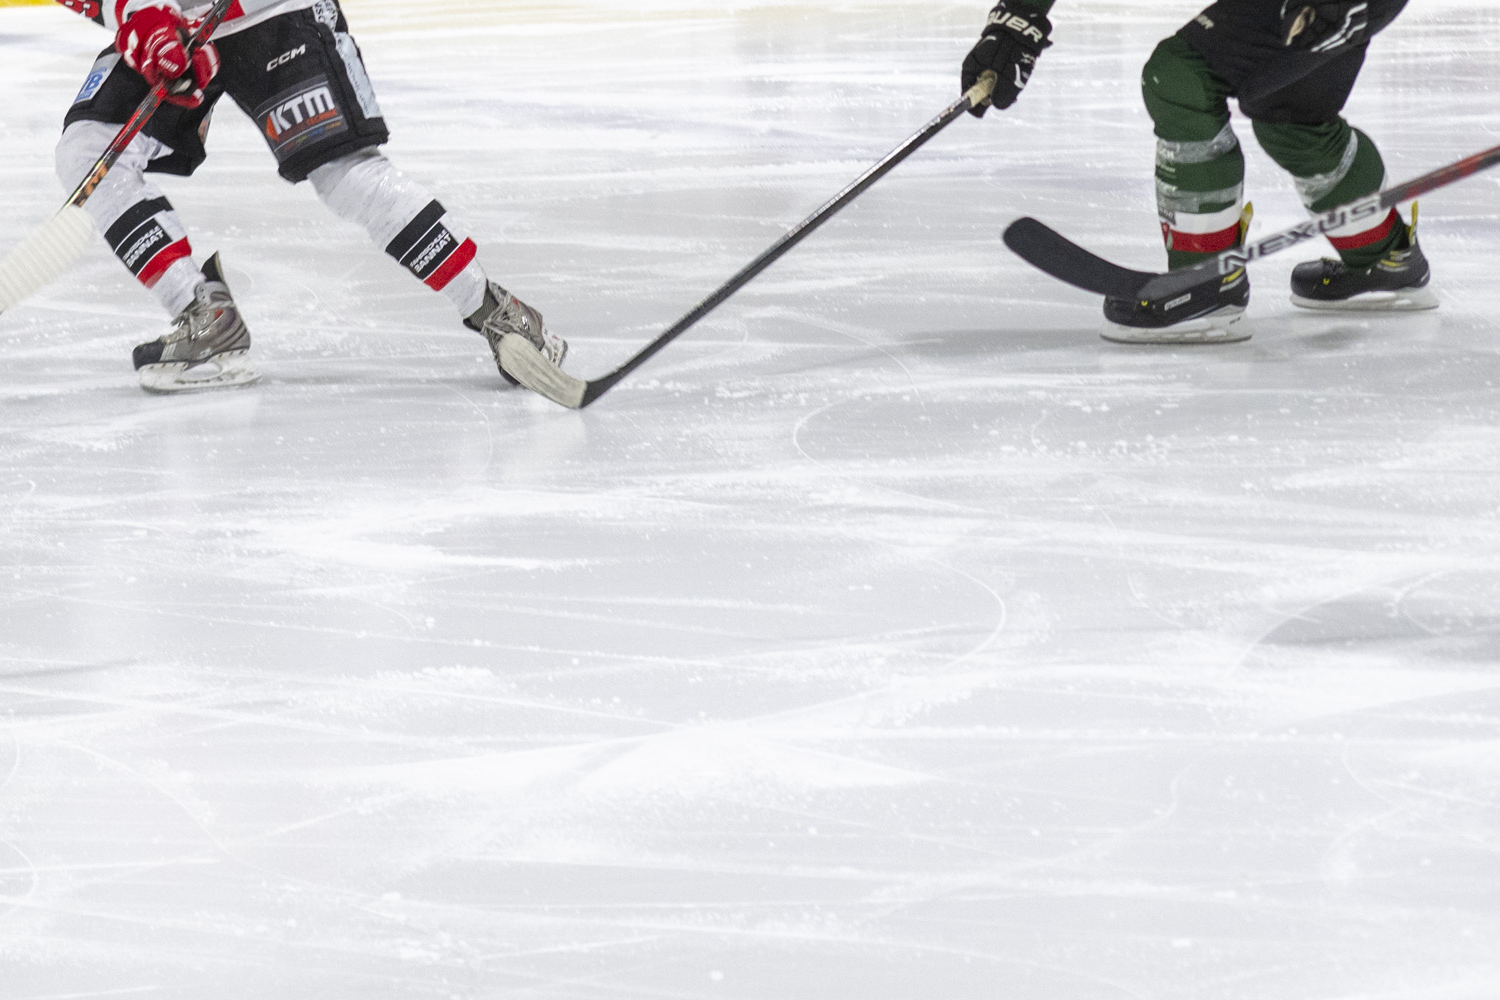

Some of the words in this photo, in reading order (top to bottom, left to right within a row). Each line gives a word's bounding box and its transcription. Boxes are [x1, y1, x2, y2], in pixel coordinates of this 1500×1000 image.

[988, 10, 1043, 44] AUER
[266, 44, 307, 71] CCM
[269, 86, 336, 136] KTM
[1218, 192, 1382, 275] NEXUS
